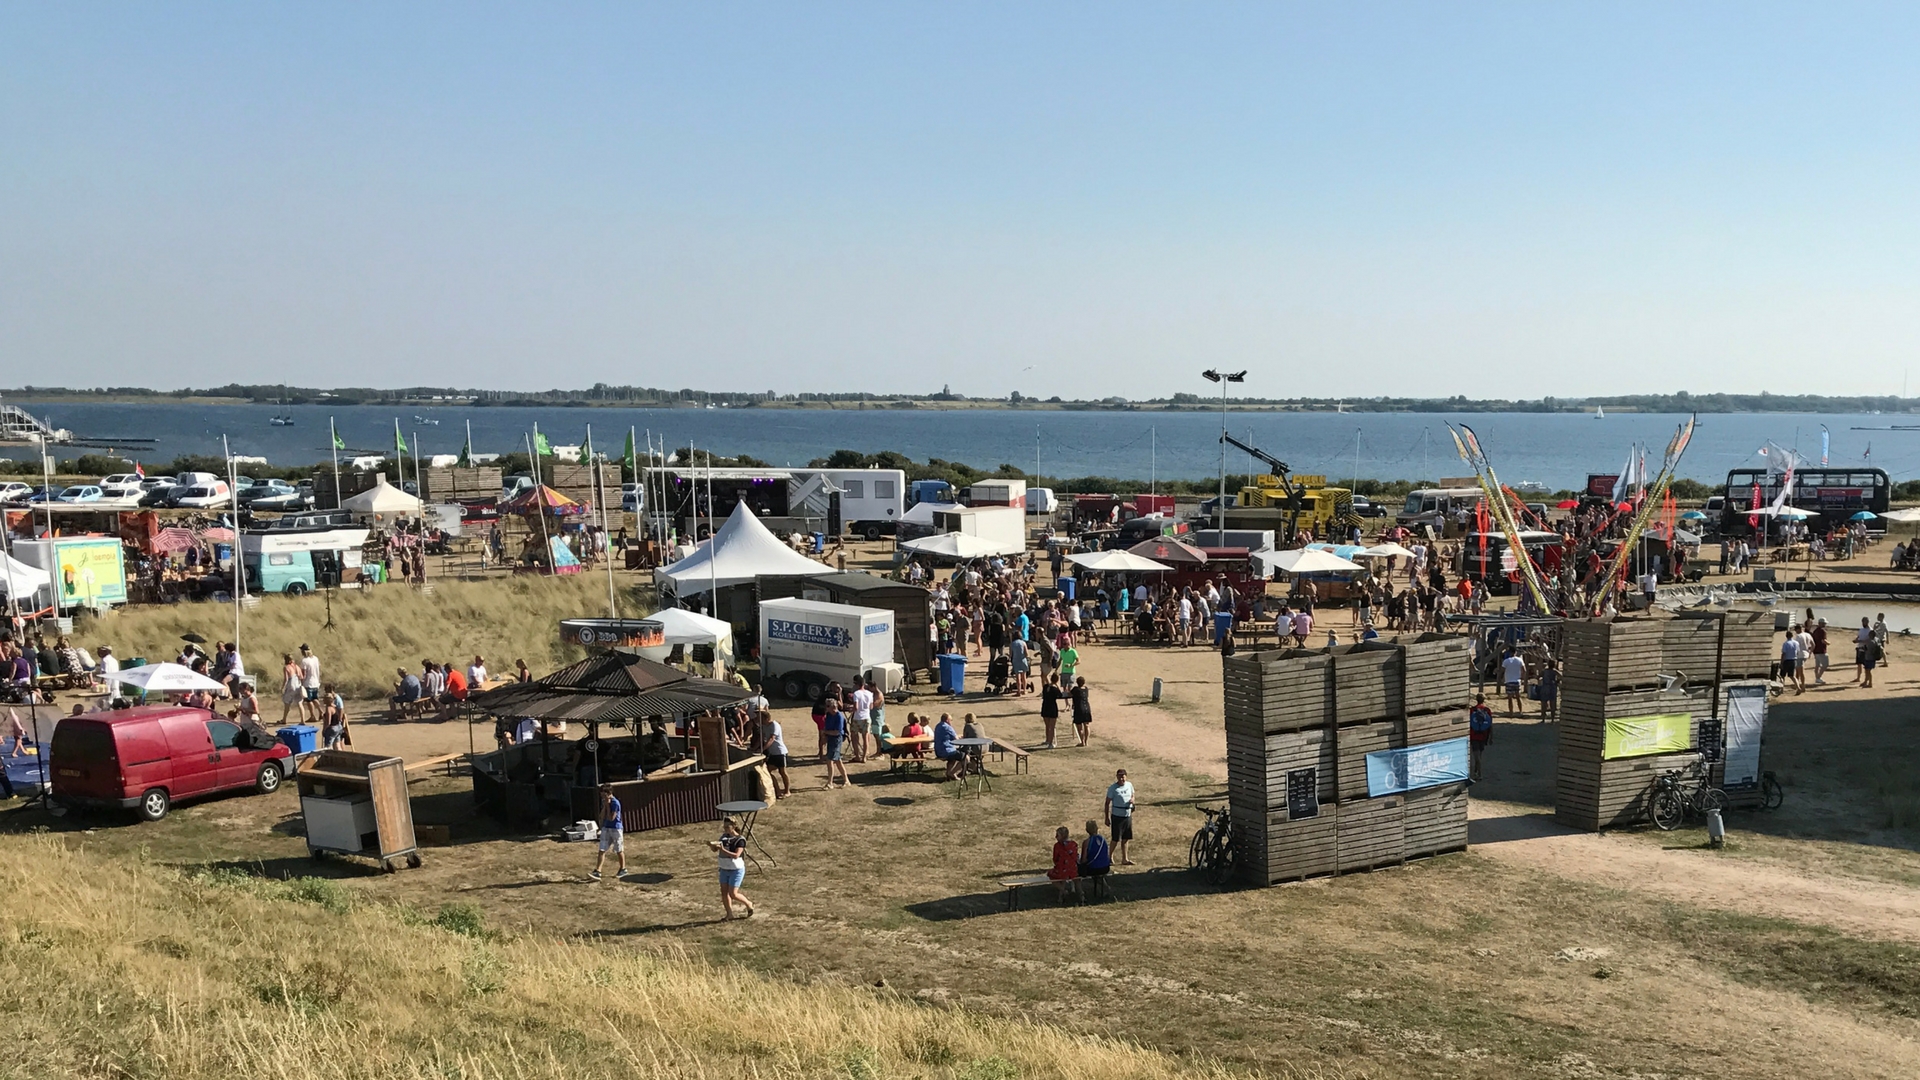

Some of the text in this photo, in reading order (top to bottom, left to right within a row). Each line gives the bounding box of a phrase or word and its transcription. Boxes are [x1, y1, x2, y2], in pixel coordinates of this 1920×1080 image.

[772, 620, 833, 638] S.P. CLERX
[772, 631, 833, 644] KOELTECHNIEK
